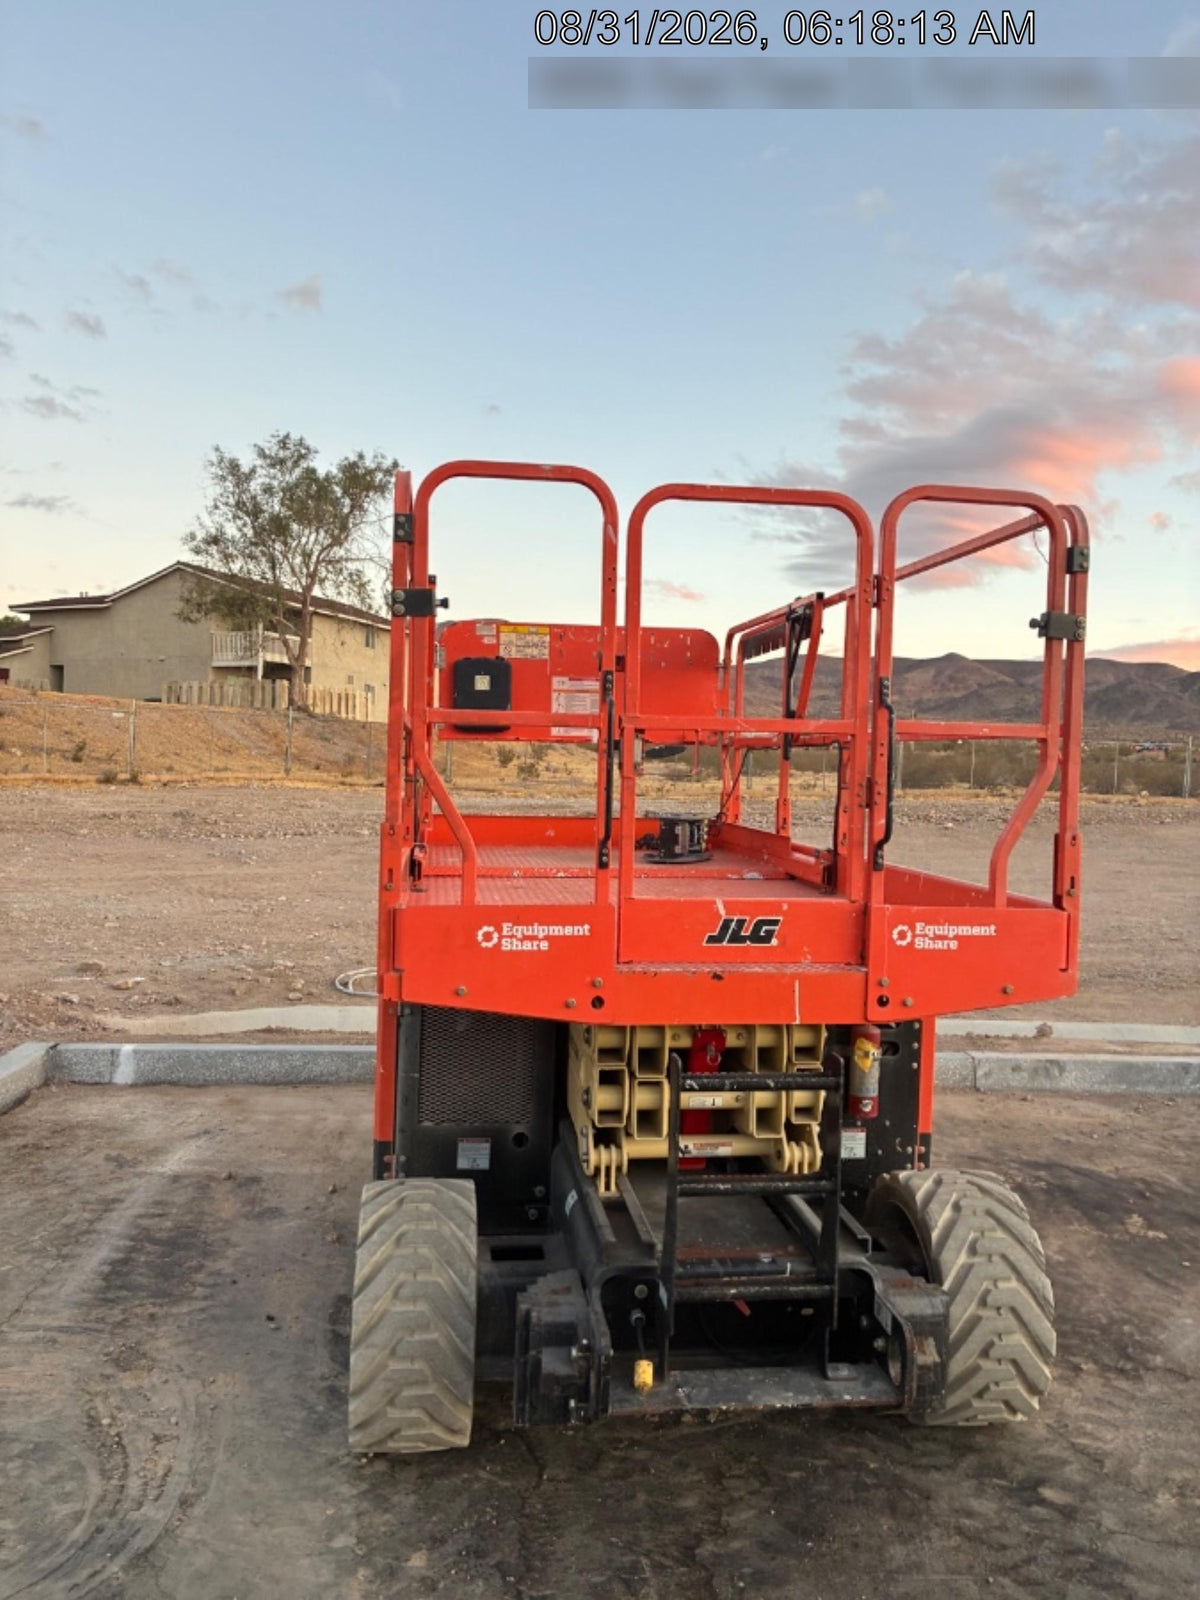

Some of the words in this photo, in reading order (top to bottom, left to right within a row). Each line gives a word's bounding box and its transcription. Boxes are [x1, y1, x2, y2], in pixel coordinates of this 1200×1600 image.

[501, 922, 591, 939] Equipment
[702, 915, 783, 946] JLG
[914, 922, 997, 938] Equipment
[500, 938, 549, 951] Share
[914, 936, 959, 950] Share
